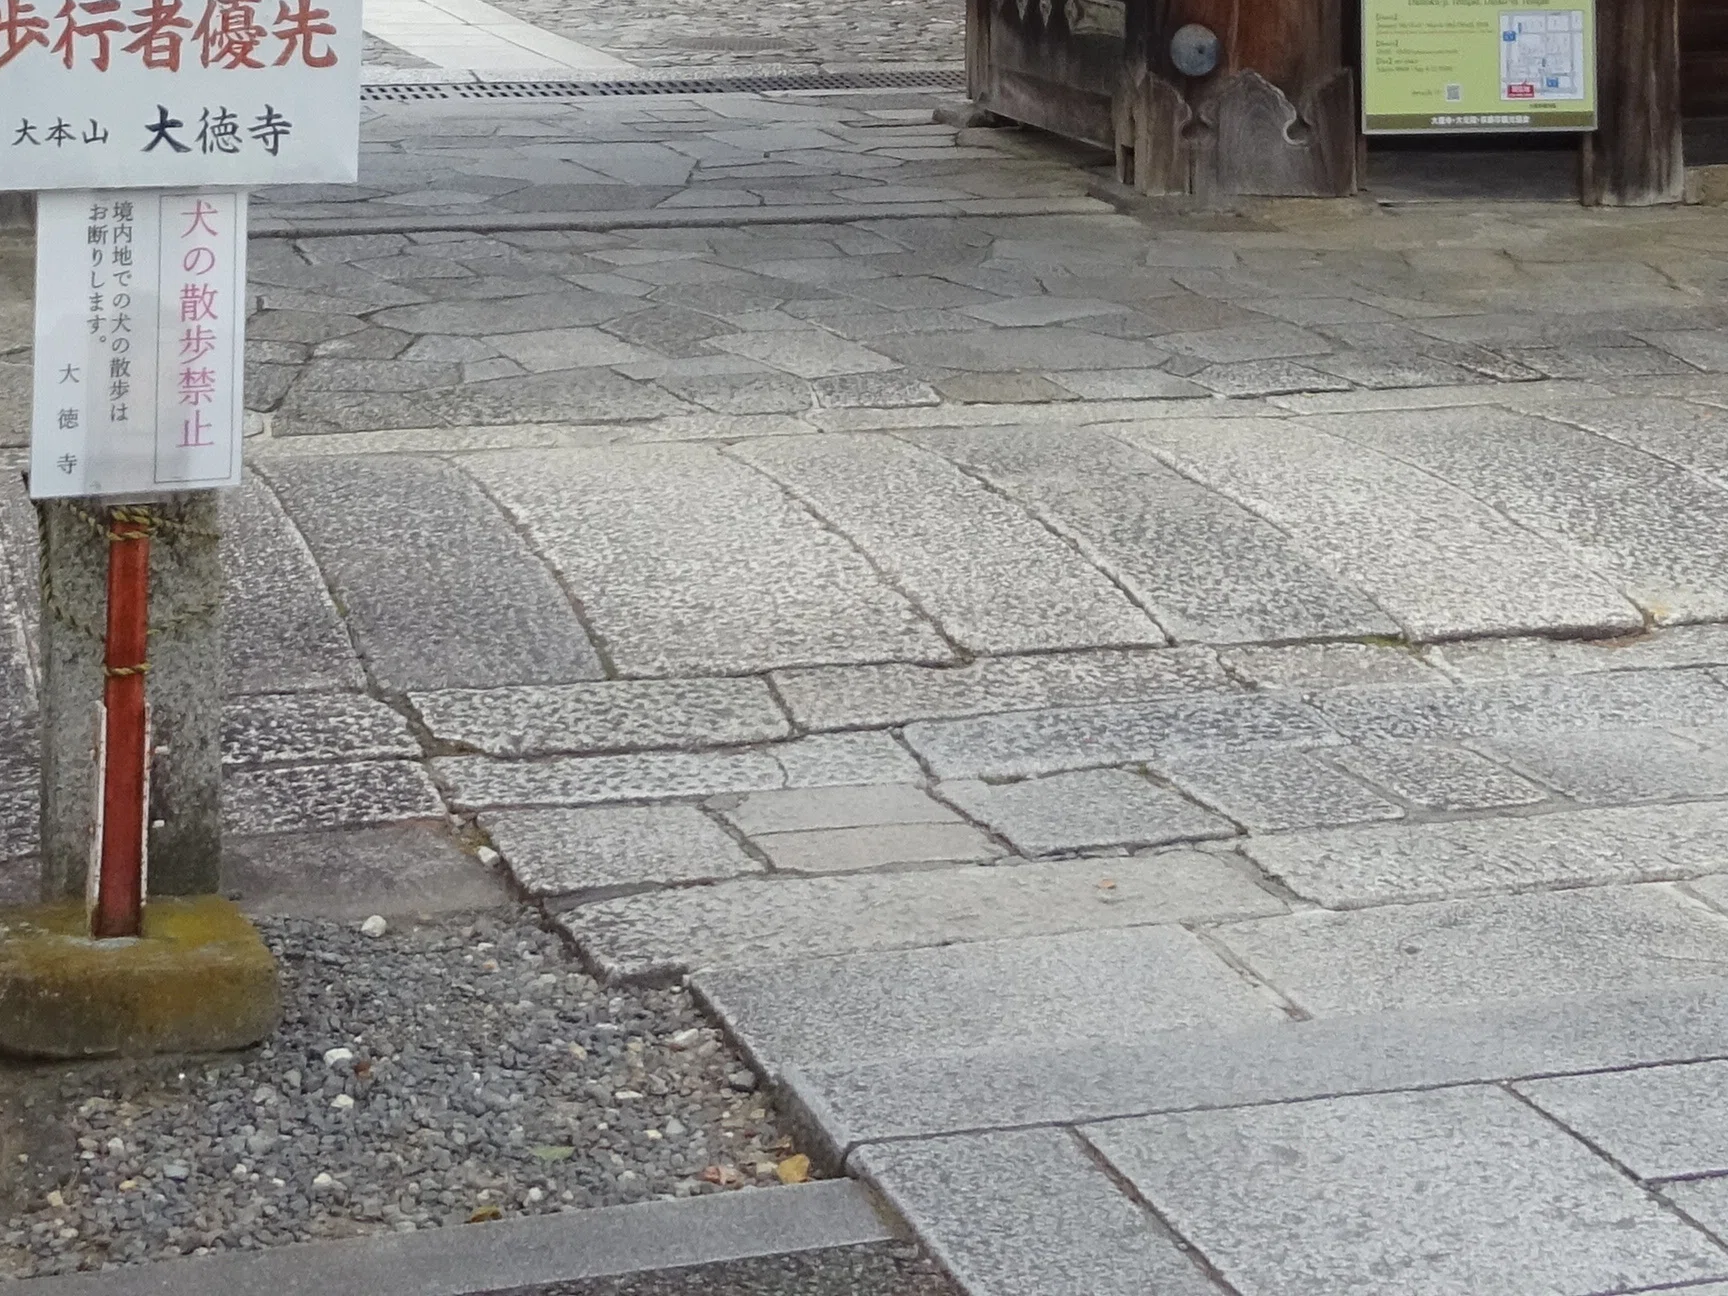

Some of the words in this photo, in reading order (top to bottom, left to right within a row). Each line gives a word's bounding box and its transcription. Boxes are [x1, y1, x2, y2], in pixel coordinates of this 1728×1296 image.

[11, 117, 109, 148] 大本山
[140, 104, 292, 157] 大徳寺
[86, 203, 108, 344] お断りします。
[109, 201, 134, 422] 境内地での犬の散歩は
[175, 198, 219, 448] 犬の散歩禁止
[57, 363, 80, 475] 大徳寺
